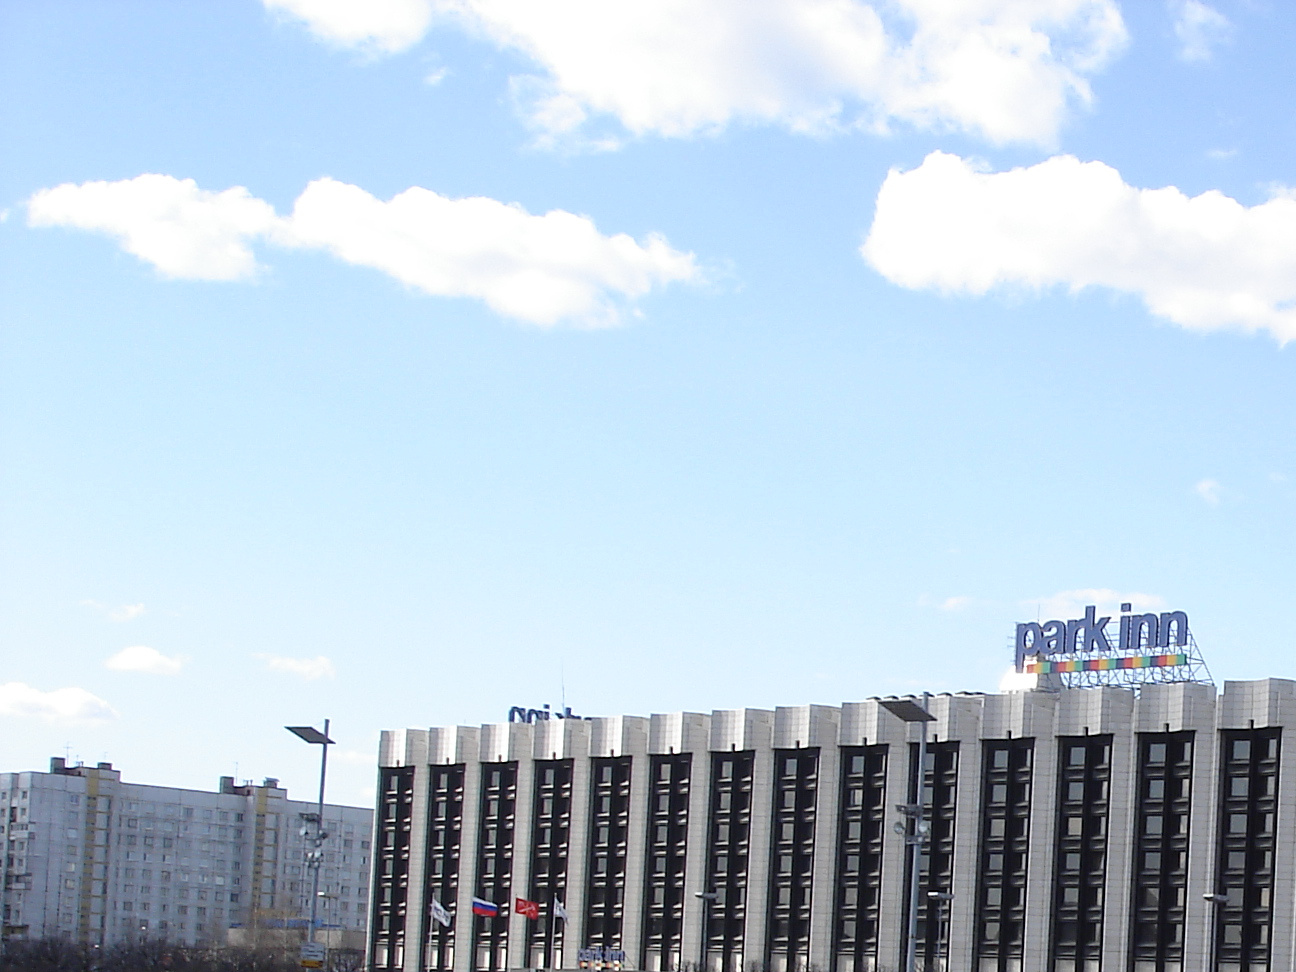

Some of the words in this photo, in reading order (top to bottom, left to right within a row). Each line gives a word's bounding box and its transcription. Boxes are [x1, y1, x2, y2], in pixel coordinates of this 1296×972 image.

[1016, 605, 1112, 673] park
[1118, 602, 1189, 650] inn
[578, 946, 603, 961] park
